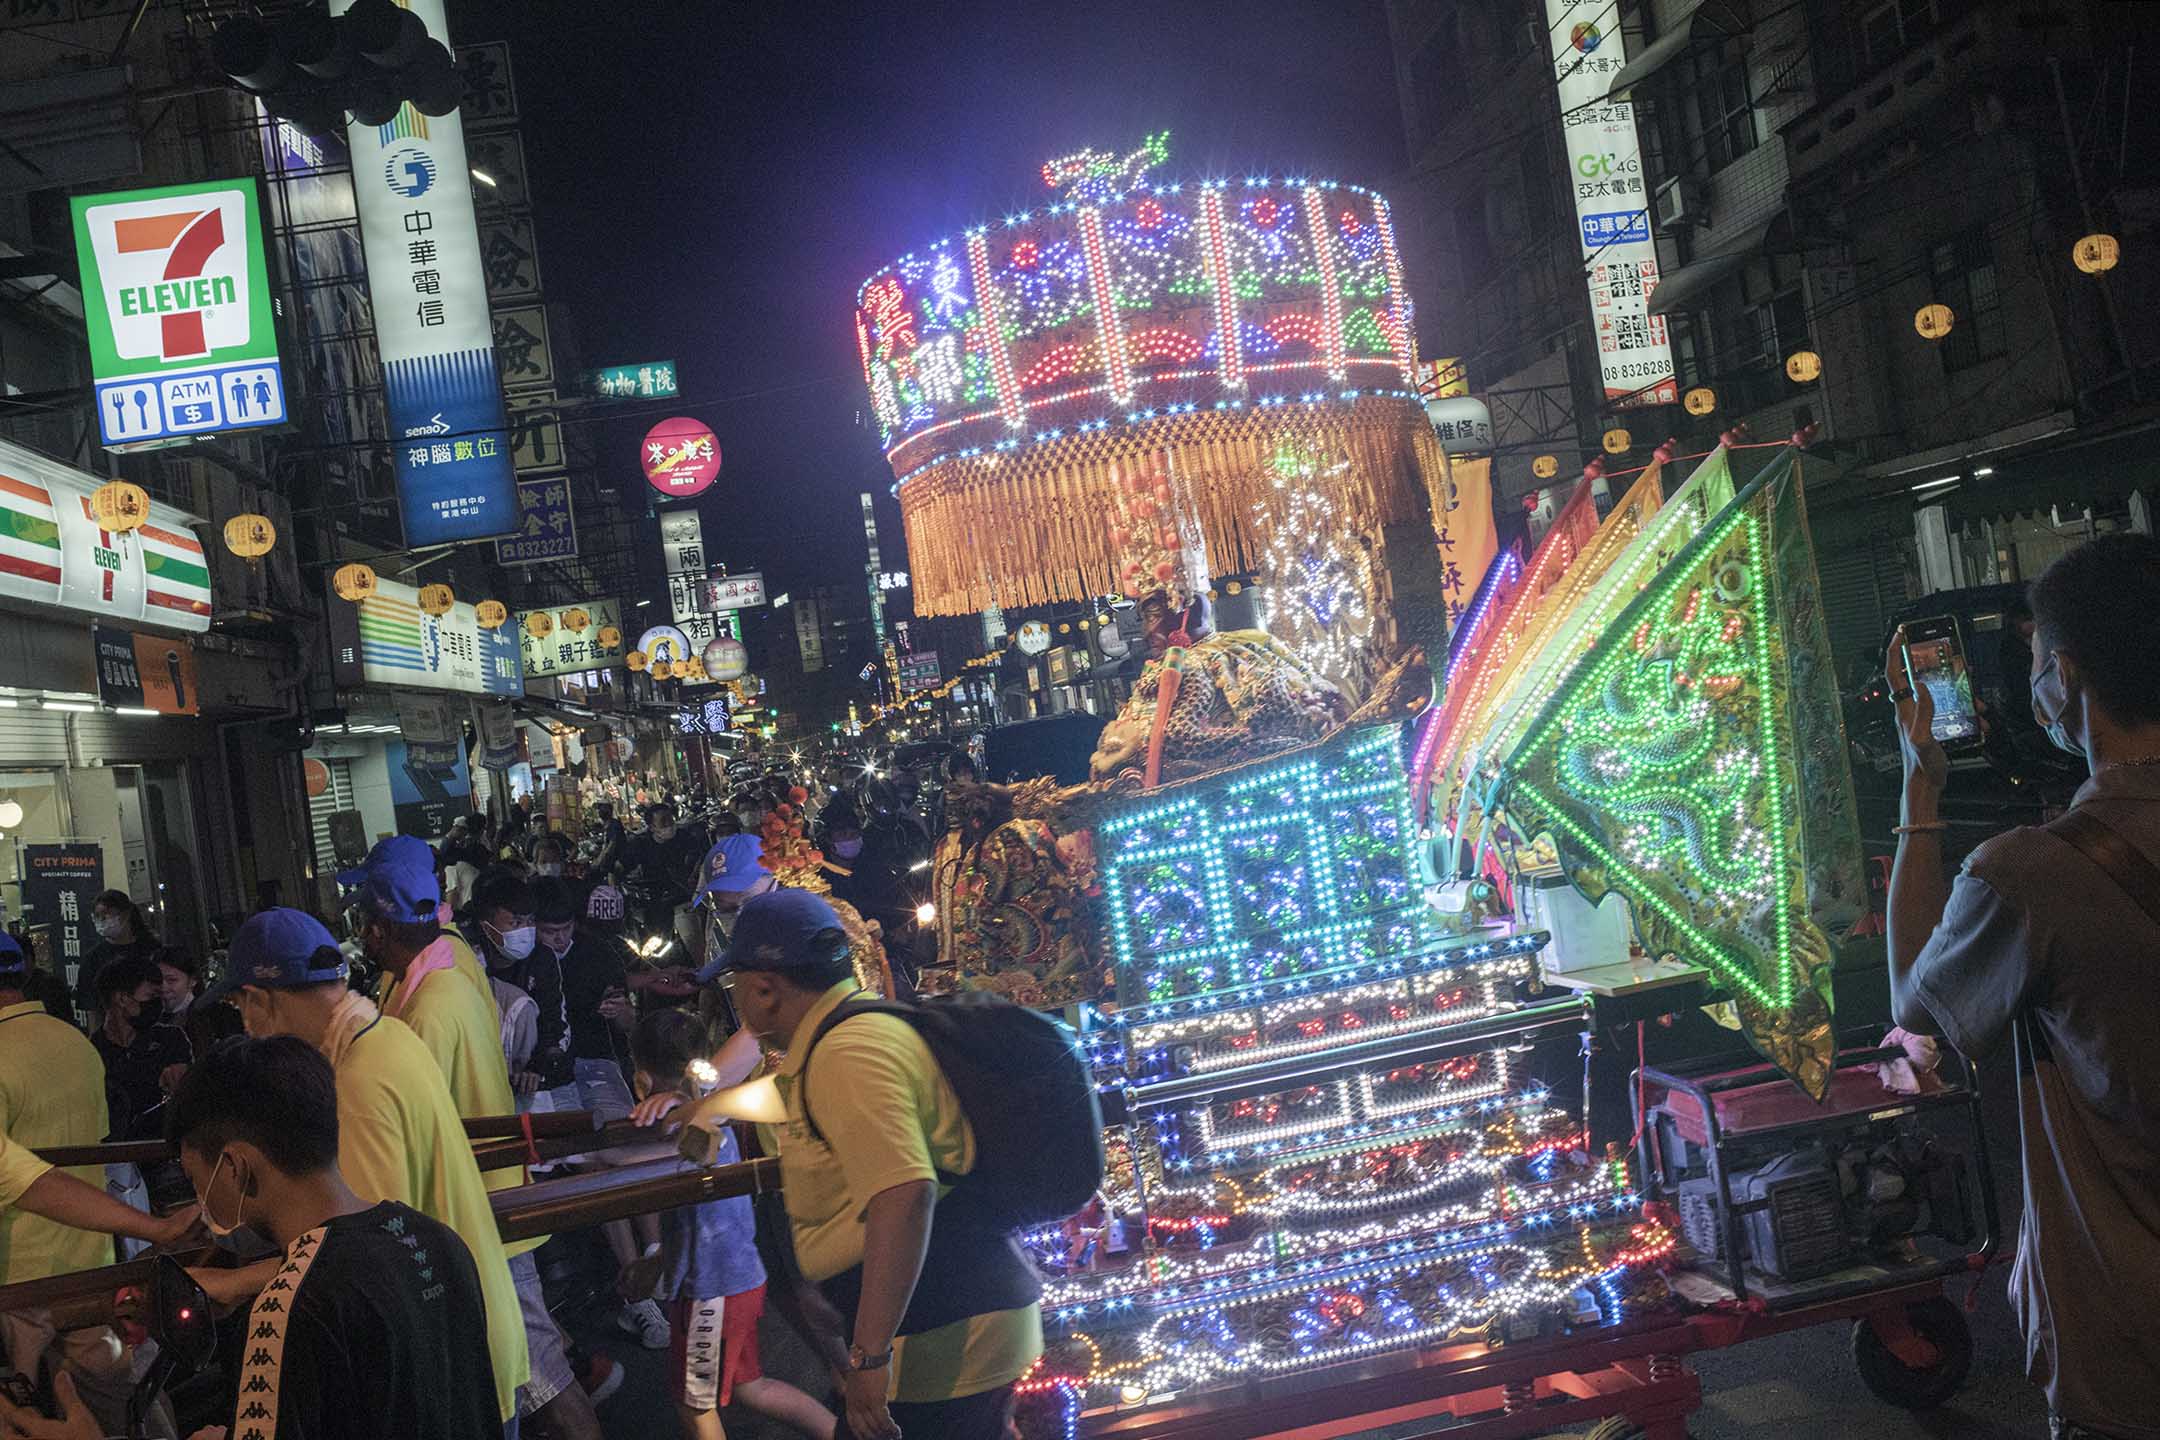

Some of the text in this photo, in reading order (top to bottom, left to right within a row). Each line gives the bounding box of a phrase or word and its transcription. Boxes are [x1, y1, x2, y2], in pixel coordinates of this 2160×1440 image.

[1566, 104, 1631, 126] 台灣之星
[1617, 159, 1638, 173] 4G
[1579, 177, 1642, 198] 亞太電信
[1583, 214, 1646, 236] 中華電信
[403, 210, 445, 328] 中華電信
[115, 207, 225, 358] 7
[170, 381, 211, 400] ATM
[597, 367, 677, 396] 動物醫院
[405, 424, 441, 438] senao
[408, 437, 497, 468] 神腦數位
[516, 535, 572, 558] 8323227
[558, 639, 621, 665] 親子鑑
[33, 856, 97, 868] CITY PRIMA
